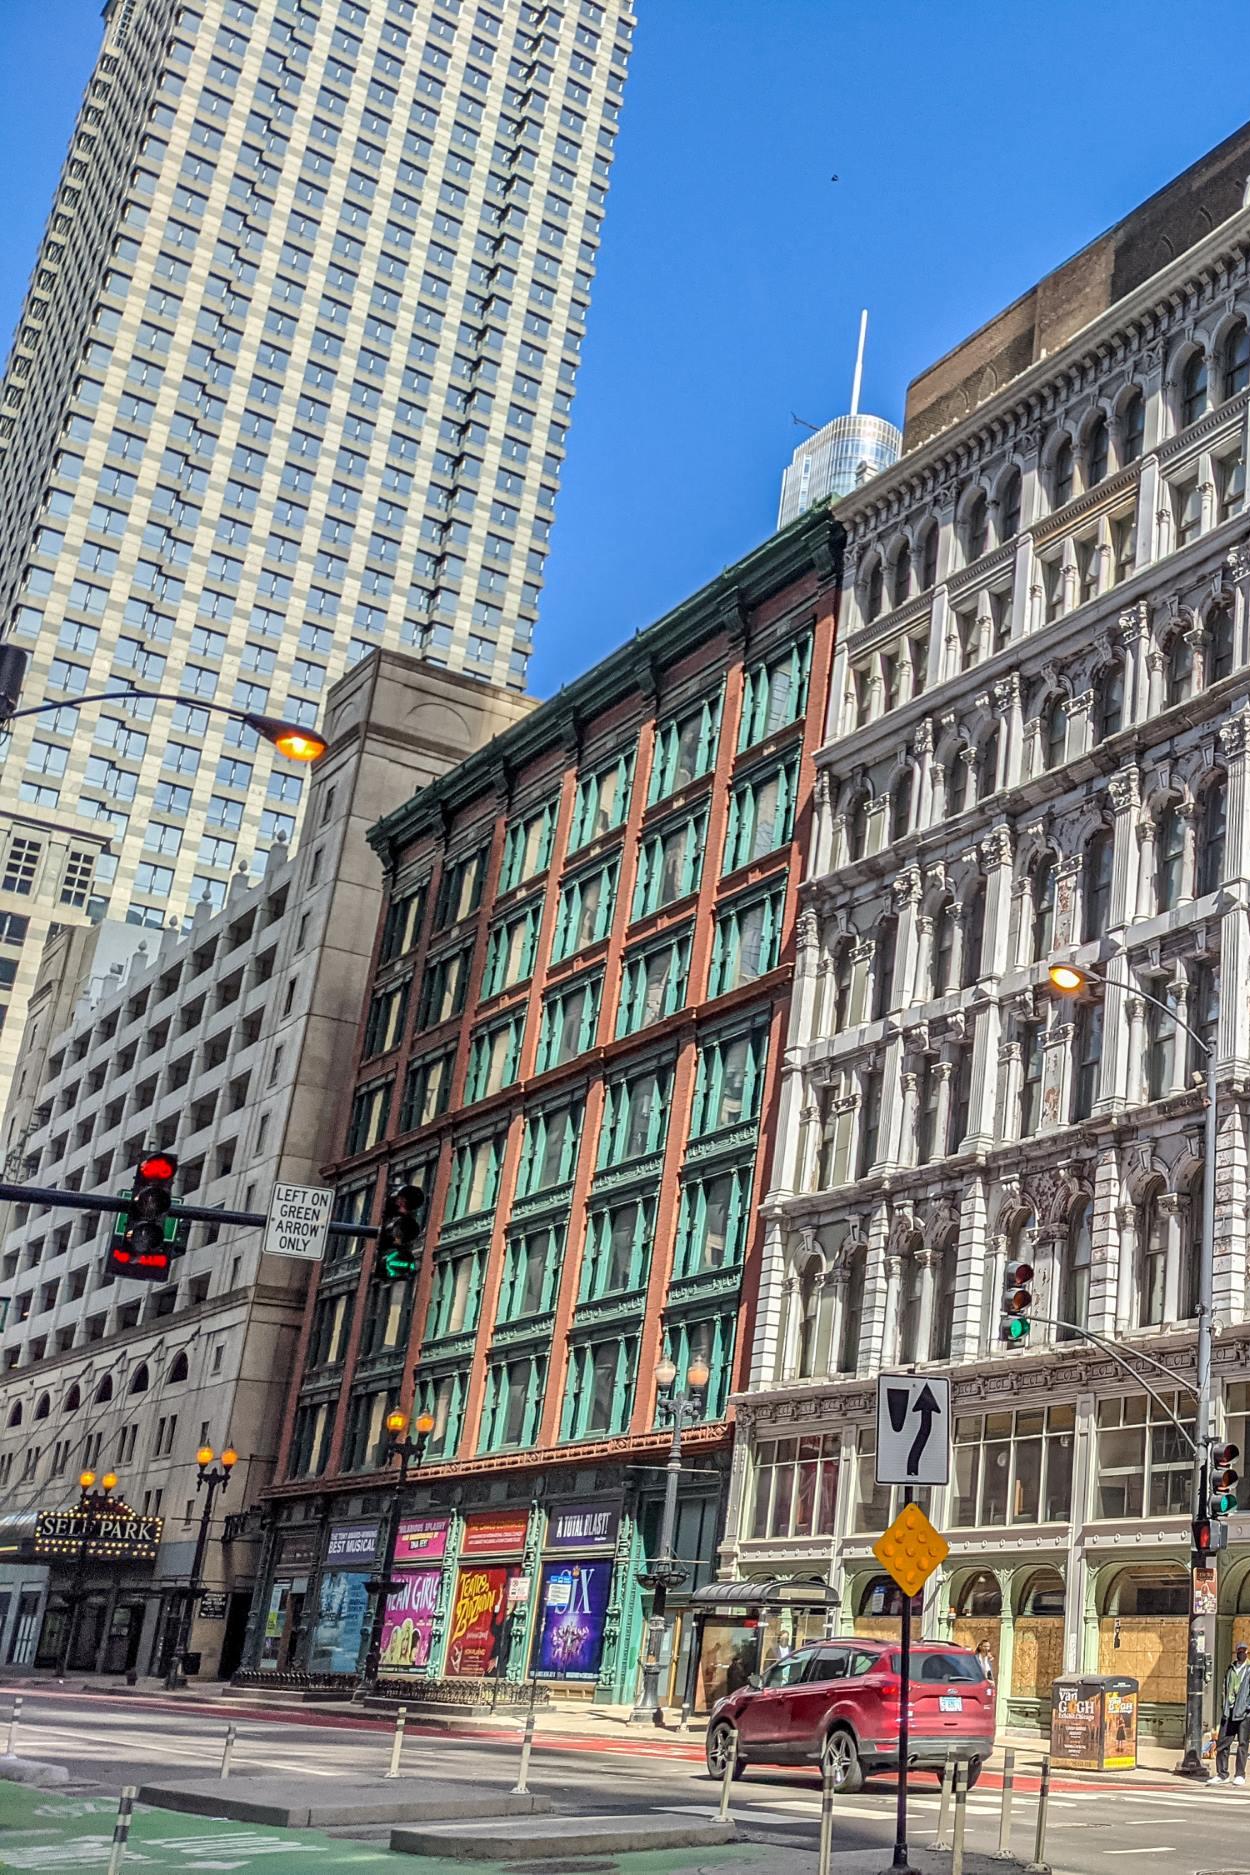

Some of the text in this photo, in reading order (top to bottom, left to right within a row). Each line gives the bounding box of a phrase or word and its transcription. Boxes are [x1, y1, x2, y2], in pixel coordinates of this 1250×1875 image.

[276, 1187, 329, 1207] LEFT ON
[280, 1204, 320, 1222] GREEN
[275, 1220, 320, 1238] ARROW
[279, 1236, 311, 1252] ONLY
[98, 1520, 153, 1540] PARK
[563, 1515, 583, 1538] TOTAL
[328, 1538, 375, 1554] BEST MUSICAL
